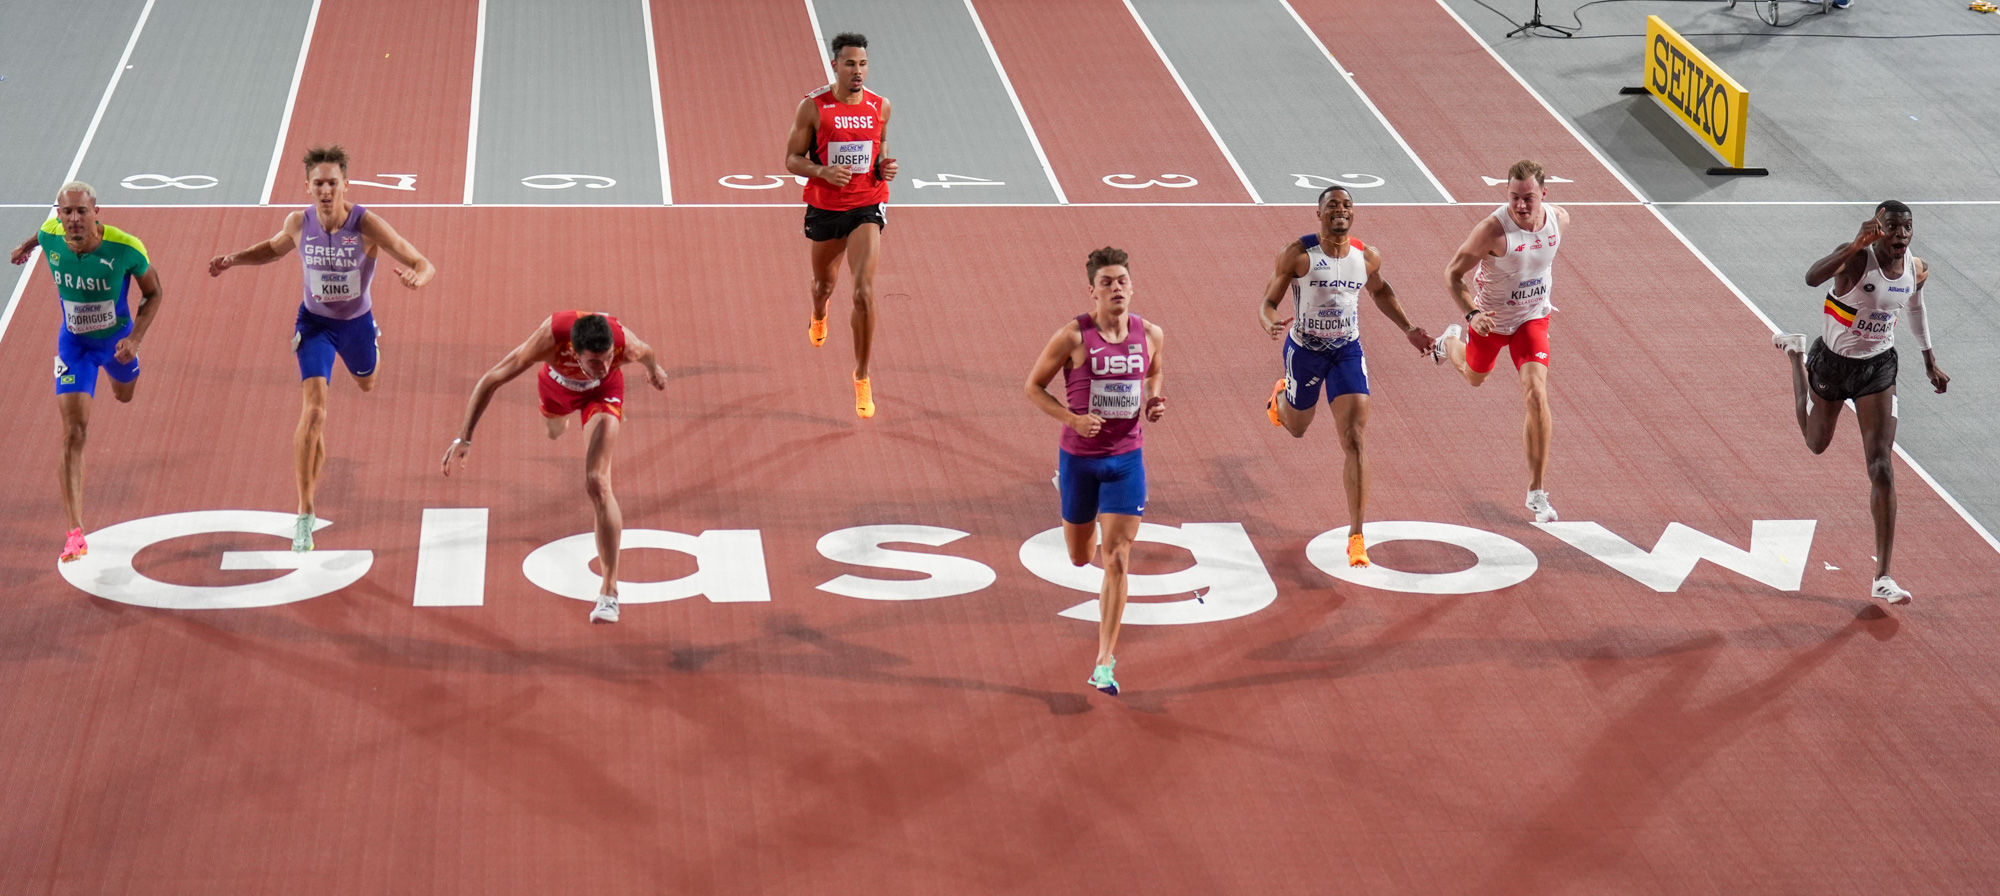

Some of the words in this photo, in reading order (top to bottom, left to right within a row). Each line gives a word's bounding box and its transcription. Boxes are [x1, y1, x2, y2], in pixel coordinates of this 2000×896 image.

[1652, 33, 1729, 146] SEIKO
[831, 154, 870, 165] JOSEPH
[120, 173, 219, 190] 8
[520, 173, 617, 190] 6
[718, 174, 809, 190] 5
[911, 173, 1006, 189] 4
[1102, 173, 1199, 189] 3
[1289, 173, 1386, 190] 2
[304, 244, 355, 257] GREAT
[305, 255, 357, 268] BRITAIN
[54, 270, 112, 291] BRASIL
[1309, 280, 1363, 289] FRANCE
[322, 284, 349, 295] KING
[1511, 285, 1547, 300] KILJAN
[1308, 317, 1351, 330] BELOCIAN
[1091, 354, 1144, 375] USA
[1092, 395, 1139, 408] CUNNINGHAM
[58, 507, 1818, 626] Glasgow
